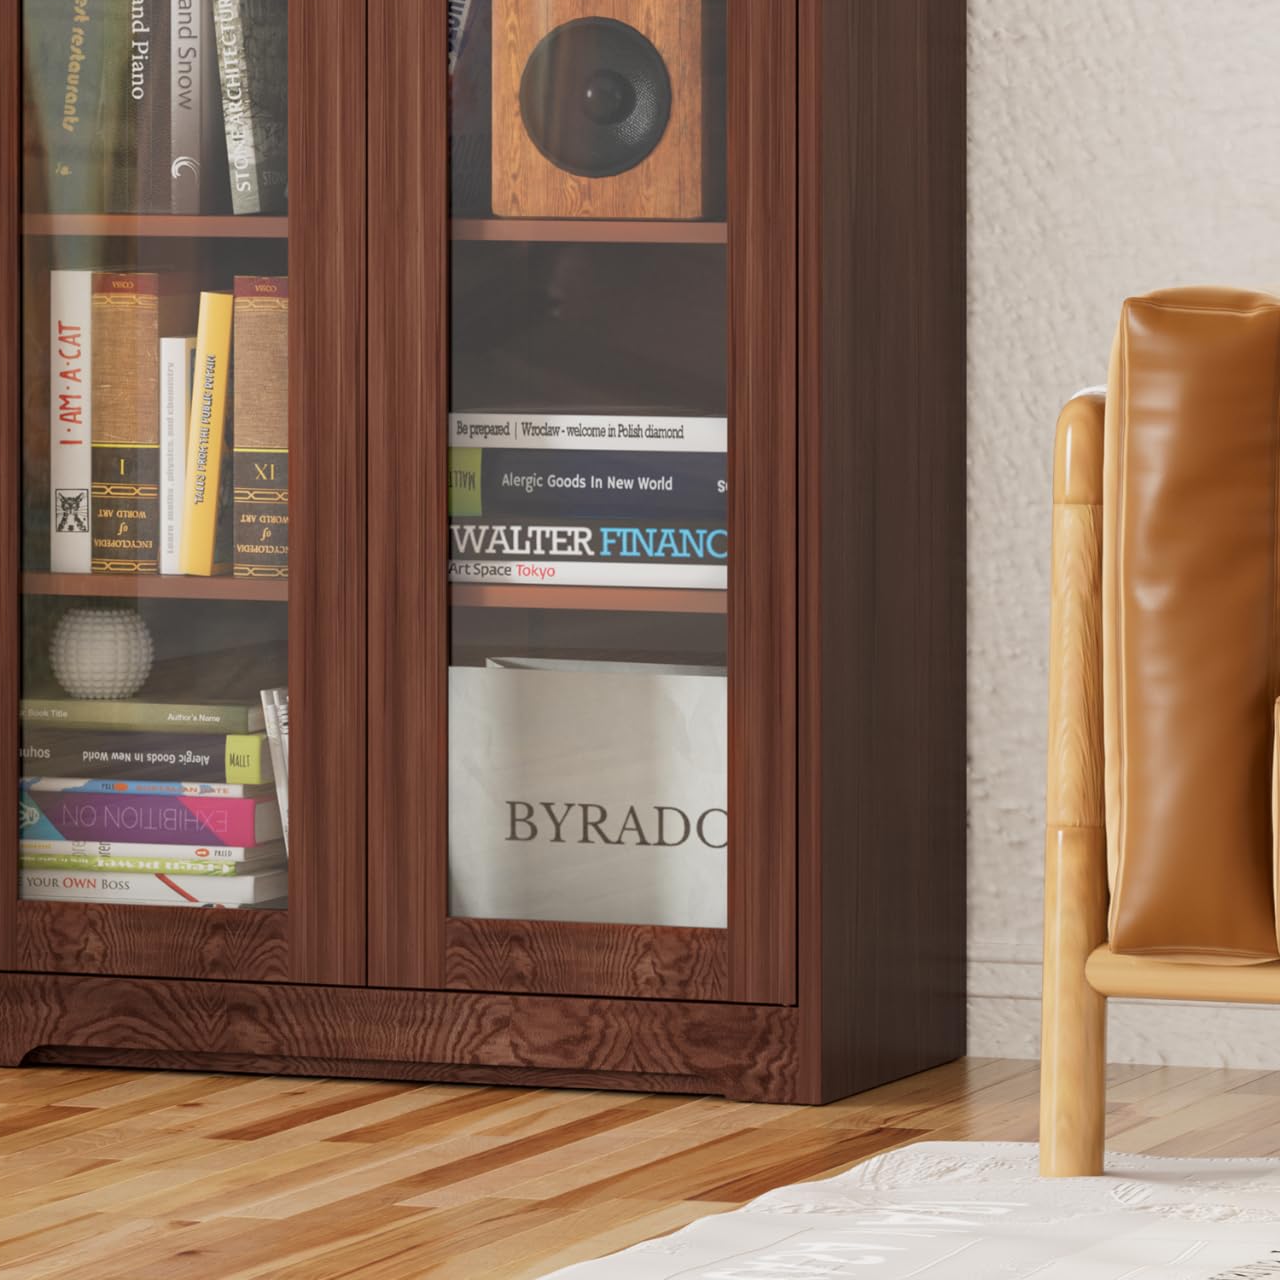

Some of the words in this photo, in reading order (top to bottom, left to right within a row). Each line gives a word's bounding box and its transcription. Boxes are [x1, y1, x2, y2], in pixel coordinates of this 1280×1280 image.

[131, 40, 150, 101] Piano
[178, 47, 197, 110] Snow
[207, 355, 217, 391] DOMAIN
[202, 390, 213, 425] PUBLIC
[200, 426, 210, 444] THE
[456, 420, 468, 435] Be
[469, 421, 510, 438] prepared
[566, 424, 606, 438] welcome
[608, 424, 616, 438] in
[618, 424, 643, 440] Polish
[645, 425, 685, 440] diamond
[198, 444, 208, 472] FROM
[194, 474, 207, 505] TALES
[501, 473, 543, 494] Alergic
[547, 474, 586, 490] Goods
[591, 475, 603, 489] In
[607, 476, 634, 490] New
[637, 477, 673, 491] World
[97, 509, 113, 519] ART
[116, 509, 147, 520] WORLD
[239, 514, 257, 524] ART
[117, 522, 128, 536] of
[259, 526, 271, 541] of
[94, 537, 154, 549] ENCYCLOPEDIA
[450, 525, 595, 556] WALTER
[449, 562, 471, 576] Art
[473, 563, 512, 579] Space
[516, 564, 556, 581] Tokyo
[51, 708, 69, 719] Title
[167, 712, 197, 723] Author's
[82, 750, 109, 762] World
[111, 751, 132, 763] New
[134, 751, 144, 762] In
[147, 751, 176, 765] Goods
[178, 752, 210, 766] Alergic
[62, 803, 97, 826] ON
[104, 806, 228, 833] EXHIBITION
[27, 876, 60, 890] YOUR
[63, 876, 97, 890] OWN
